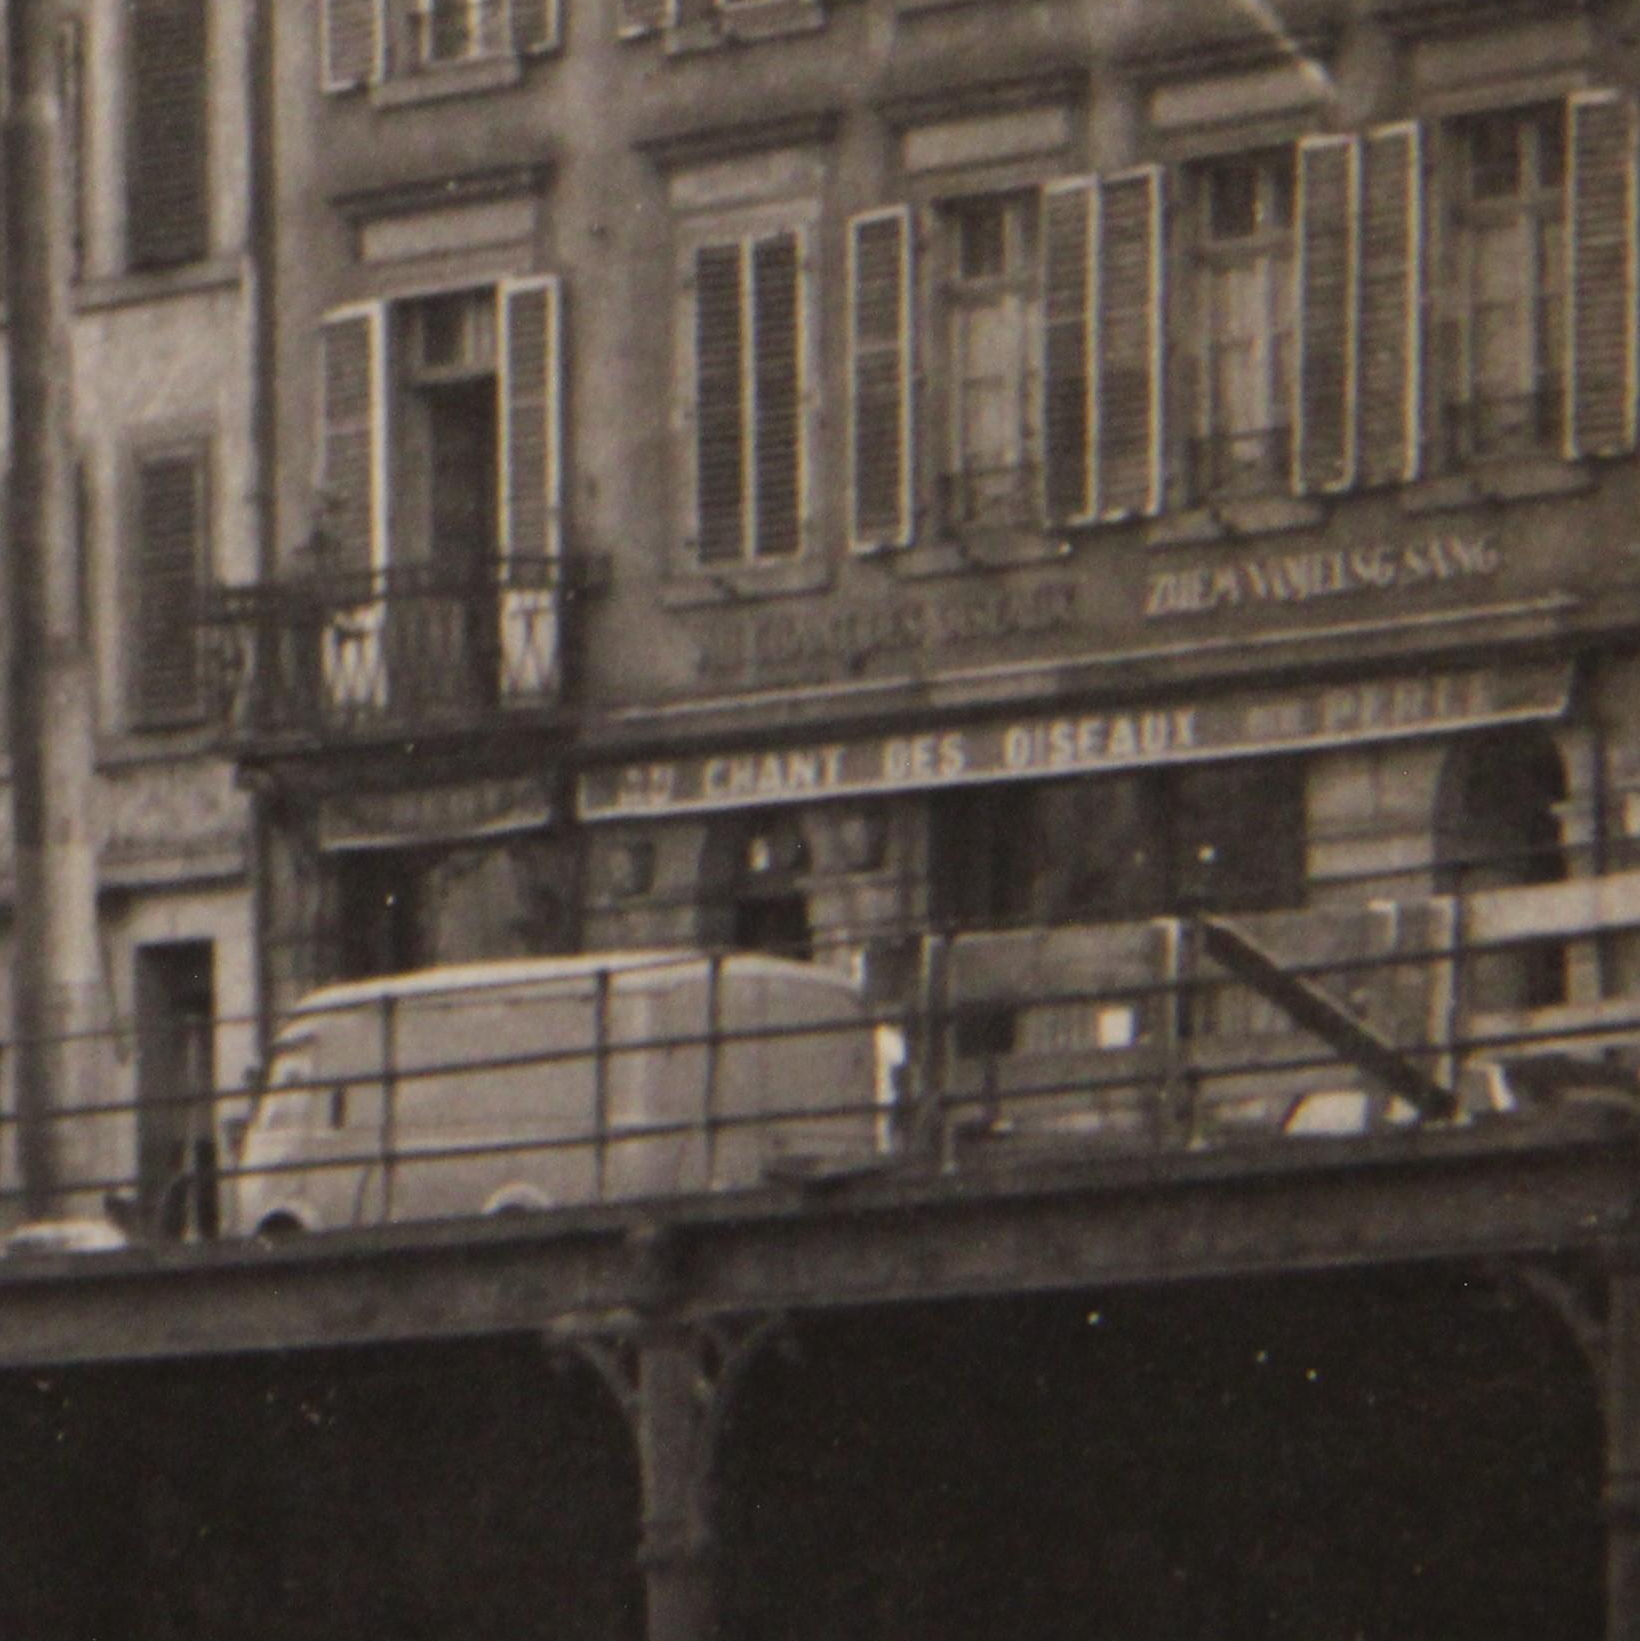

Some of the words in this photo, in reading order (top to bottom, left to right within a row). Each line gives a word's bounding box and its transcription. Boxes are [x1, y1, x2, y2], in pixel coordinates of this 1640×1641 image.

[702, 746, 846, 798] CHANT
[882, 734, 966, 780] DES
[1003, 709, 1198, 770] OISEAUX
